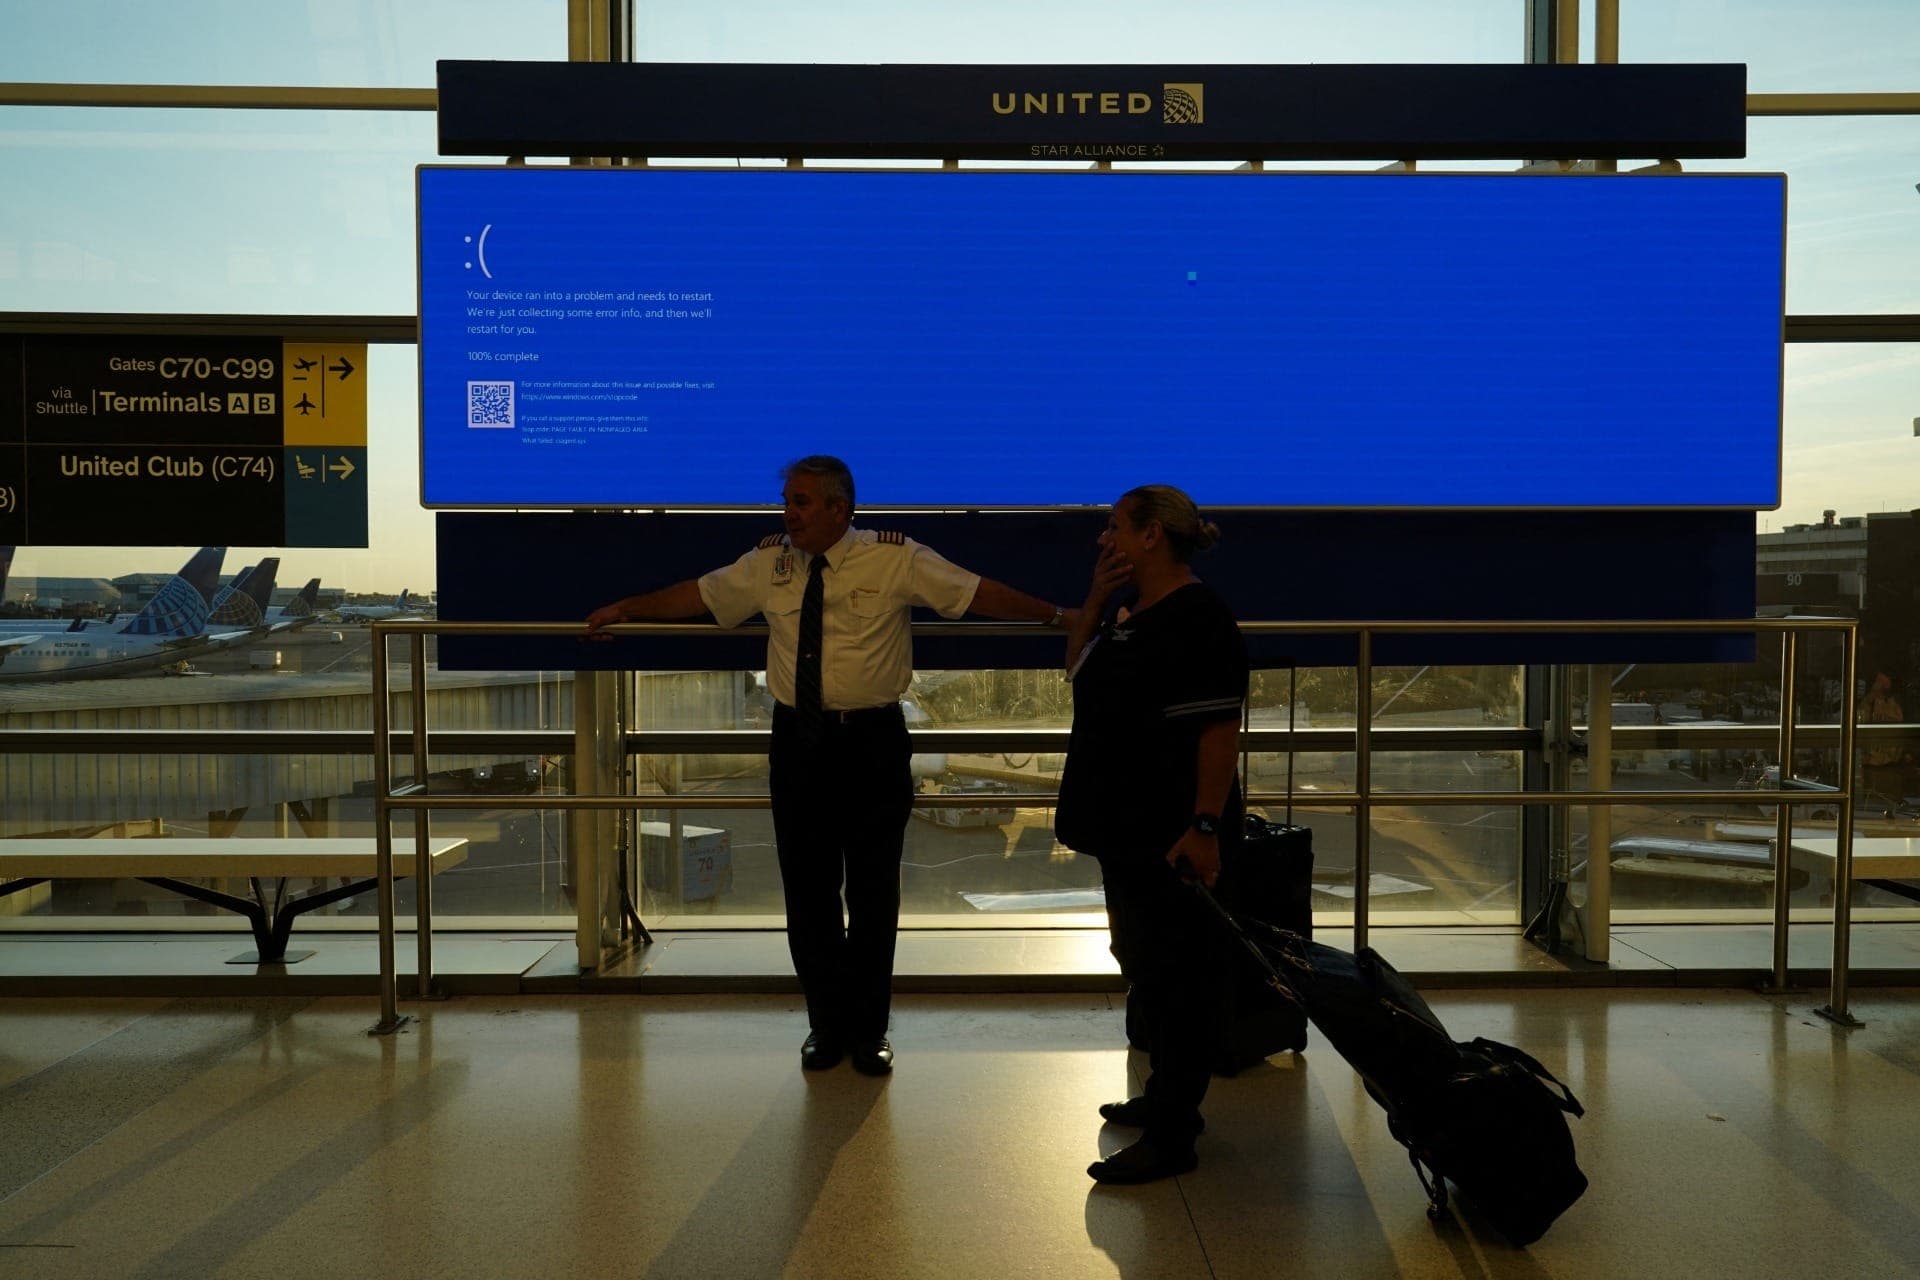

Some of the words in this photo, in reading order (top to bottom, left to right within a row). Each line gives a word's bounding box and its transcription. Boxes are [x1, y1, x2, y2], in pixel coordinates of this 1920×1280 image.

[992, 92, 1153, 114] UNITED
[1031, 145, 1068, 156] STAR
[1074, 145, 1147, 156] ALLIANCE
[466, 290, 490, 301] Your
[491, 290, 523, 301] device
[525, 292, 541, 300] ran
[543, 290, 563, 301] into
[565, 292, 571, 300] a
[574, 290, 613, 303] problem
[616, 291, 635, 301] and
[637, 291, 665, 301] needs
[668, 291, 679, 301] to
[681, 291, 714, 302] restart.
[466, 307, 495, 317] We're
[498, 307, 515, 319] just
[518, 307, 564, 320] collecting
[567, 309, 593, 318] some
[595, 309, 619, 318] error
[621, 307, 643, 320] info,
[645, 308, 664, 318] and
[666, 308, 688, 318] then
[690, 308, 712, 318] we'll
[467, 325, 498, 335] restart
[500, 324, 515, 335] for
[516, 327, 537, 337] you.
[468, 351, 492, 361] 100%
[494, 351, 540, 364] complete
[109, 357, 156, 372] Gates
[158, 357, 275, 380] C70-C99
[521, 380, 532, 389] For
[533, 381, 552, 389] more
[552, 380, 590, 389] information
[591, 380, 610, 389] about
[642, 381, 656, 389] and
[51, 386, 73, 399] via
[35, 401, 88, 415] Shuttle
[100, 391, 222, 414] Terminals
[230, 395, 246, 412] A
[257, 395, 273, 413] B
[60, 454, 140, 477] United
[146, 454, 205, 478] Club
[211, 456, 276, 482] (C74)
[1786, 574, 1802, 586] 90
